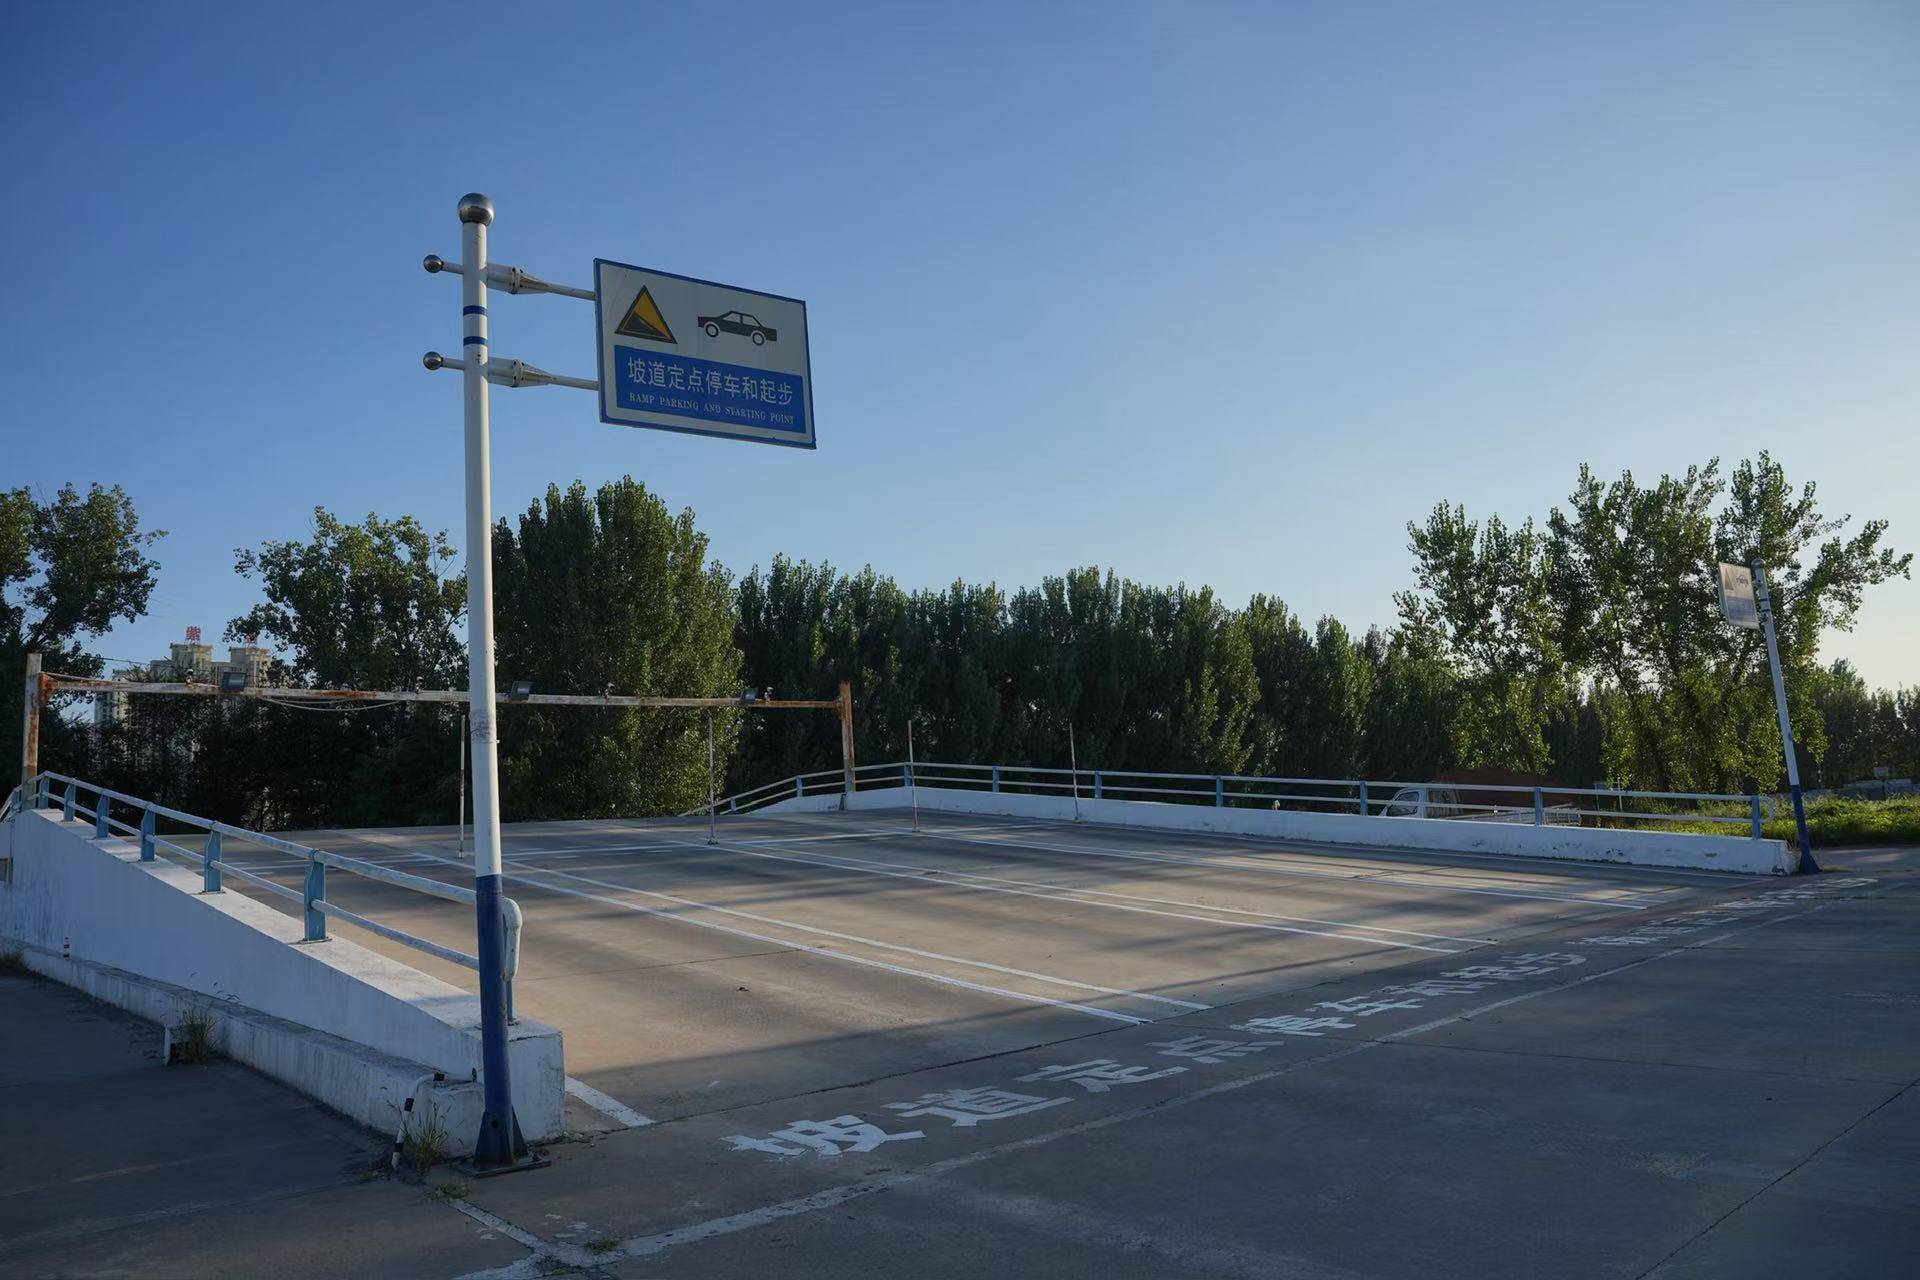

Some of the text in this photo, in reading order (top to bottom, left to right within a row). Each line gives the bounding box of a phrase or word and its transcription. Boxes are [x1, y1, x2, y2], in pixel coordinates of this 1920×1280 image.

[627, 356, 793, 405] 坡道定点停车和起步
[629, 392, 794, 424] RAMP PARKING AND STARTING POINT
[720, 952, 1586, 1158] 坡道定点停车和起步
